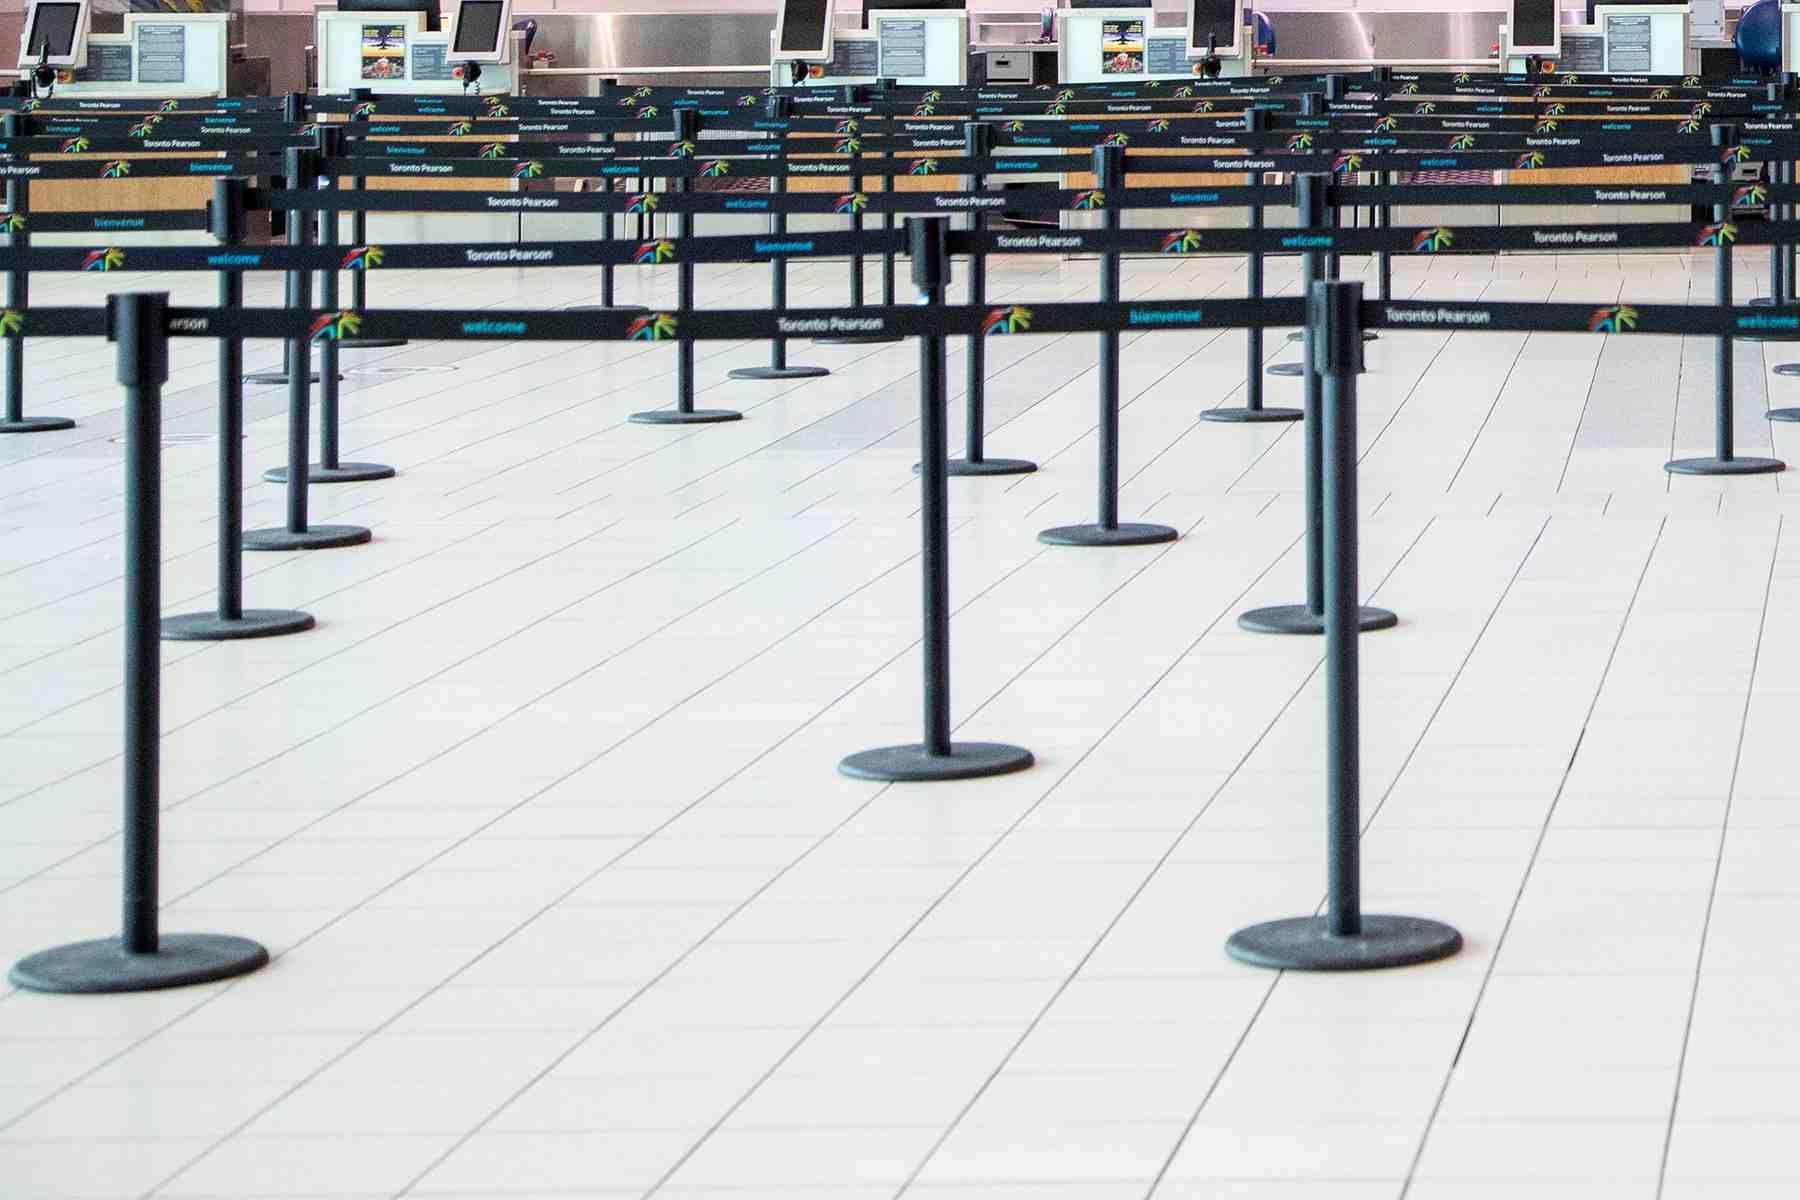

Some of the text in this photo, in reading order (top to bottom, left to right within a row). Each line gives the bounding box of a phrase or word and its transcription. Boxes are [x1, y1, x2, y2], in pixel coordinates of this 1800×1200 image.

[144, 140, 200, 148] Toronto Pearson
[1181, 136, 1235, 145] Toronto Pearson
[1526, 137, 1579, 145] Toronto Pearson
[559, 146, 615, 154] Toronto Pearson
[1603, 152, 1663, 162] Toronto Pearson
[190, 163, 233, 172] bienvenue
[390, 164, 453, 173] Toronto Pearson
[788, 163, 849, 172] Toronto Pearson
[1214, 160, 1274, 169] Toronto Pearson
[7, 166, 39, 175] Pearson
[1596, 190, 1665, 200] Toronto Pearson
[488, 197, 558, 208] Toronto Pearson
[726, 199, 768, 208] welcome
[936, 197, 1004, 206] Toronto Pearson
[95, 218, 144, 227] bienvenue
[1281, 235, 1333, 247] welcome
[1534, 230, 1617, 243] Toronto Pearson
[998, 236, 1081, 248] Toronto Pearson
[208, 253, 261, 265] welcome
[467, 249, 552, 261] Toronto Pearson
[1386, 308, 1490, 323] Toronto Pearson
[778, 317, 883, 332] Toronto Pearson
[1737, 313, 1800, 328] welcome
[463, 320, 527, 334] welcome
